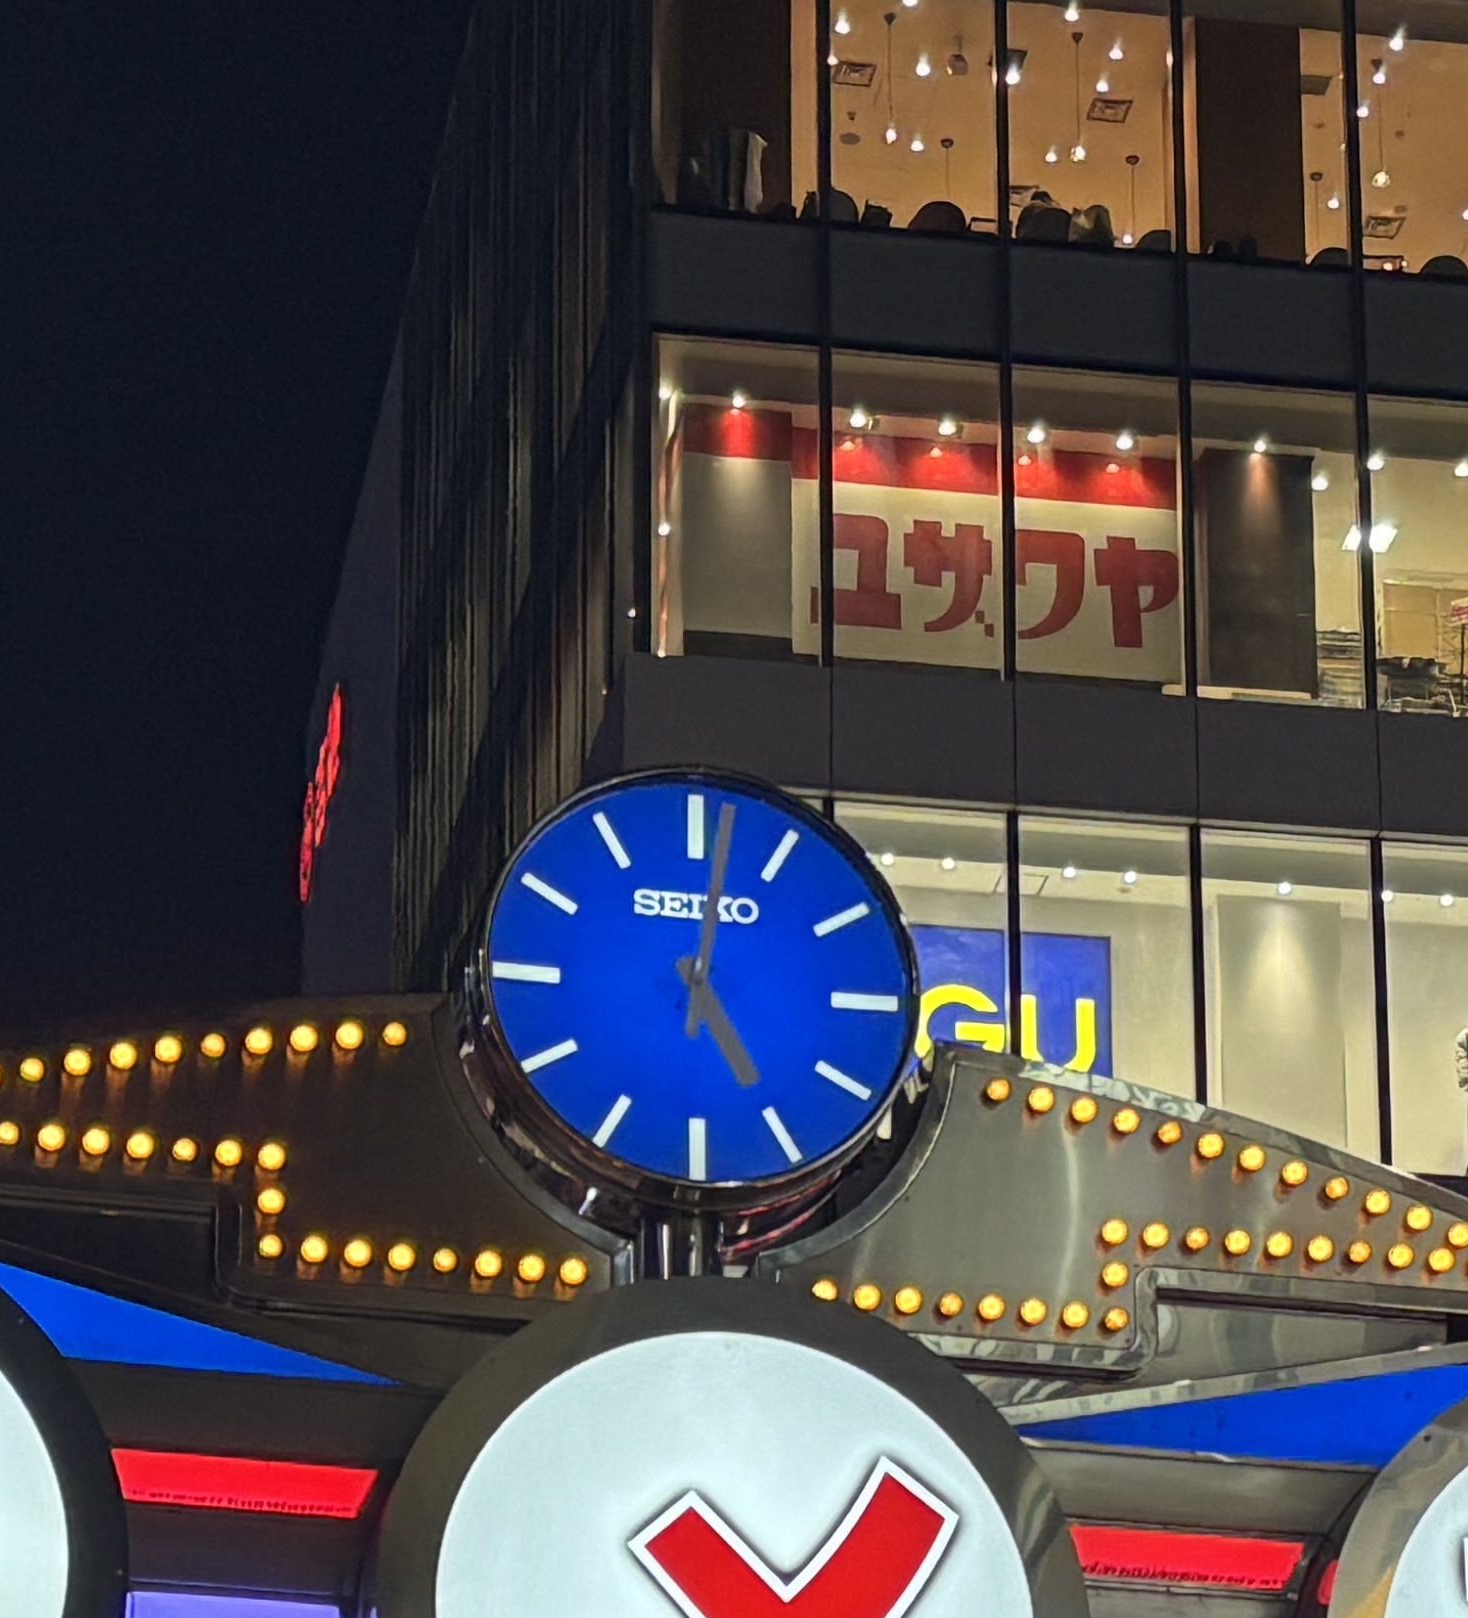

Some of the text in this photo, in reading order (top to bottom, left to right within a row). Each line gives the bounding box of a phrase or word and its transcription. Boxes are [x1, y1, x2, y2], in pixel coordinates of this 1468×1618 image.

[809, 513, 1180, 650] ユザワヤ
[633, 888, 760, 925] SEIKO
[916, 983, 1097, 1073] GU
